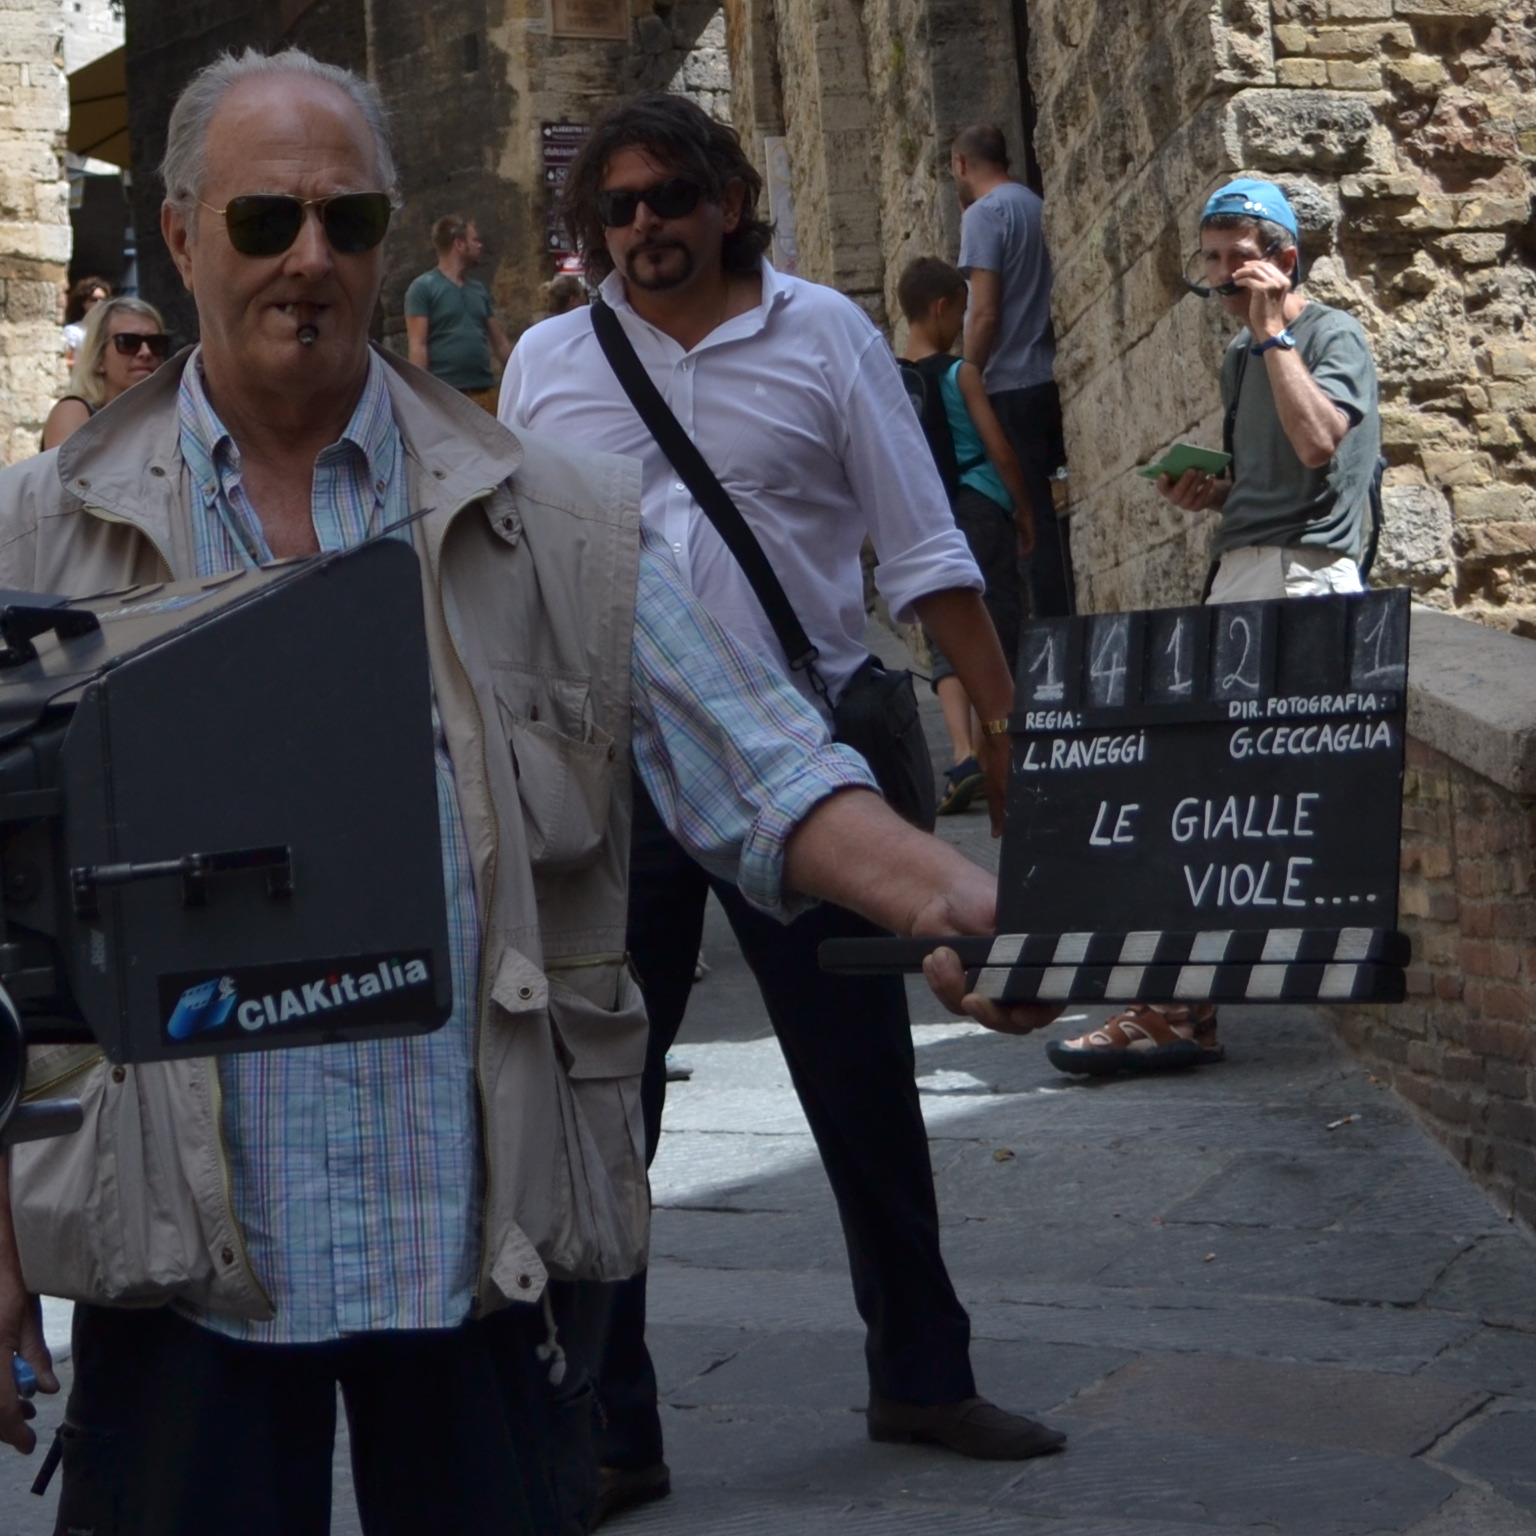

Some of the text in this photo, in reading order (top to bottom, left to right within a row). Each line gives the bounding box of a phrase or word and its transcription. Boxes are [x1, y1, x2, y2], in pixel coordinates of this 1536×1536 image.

[1025, 711, 1083, 730] REGIA:
[1088, 792, 1320, 846] LE GIALLE
[237, 957, 428, 1031] CIAKitalia
